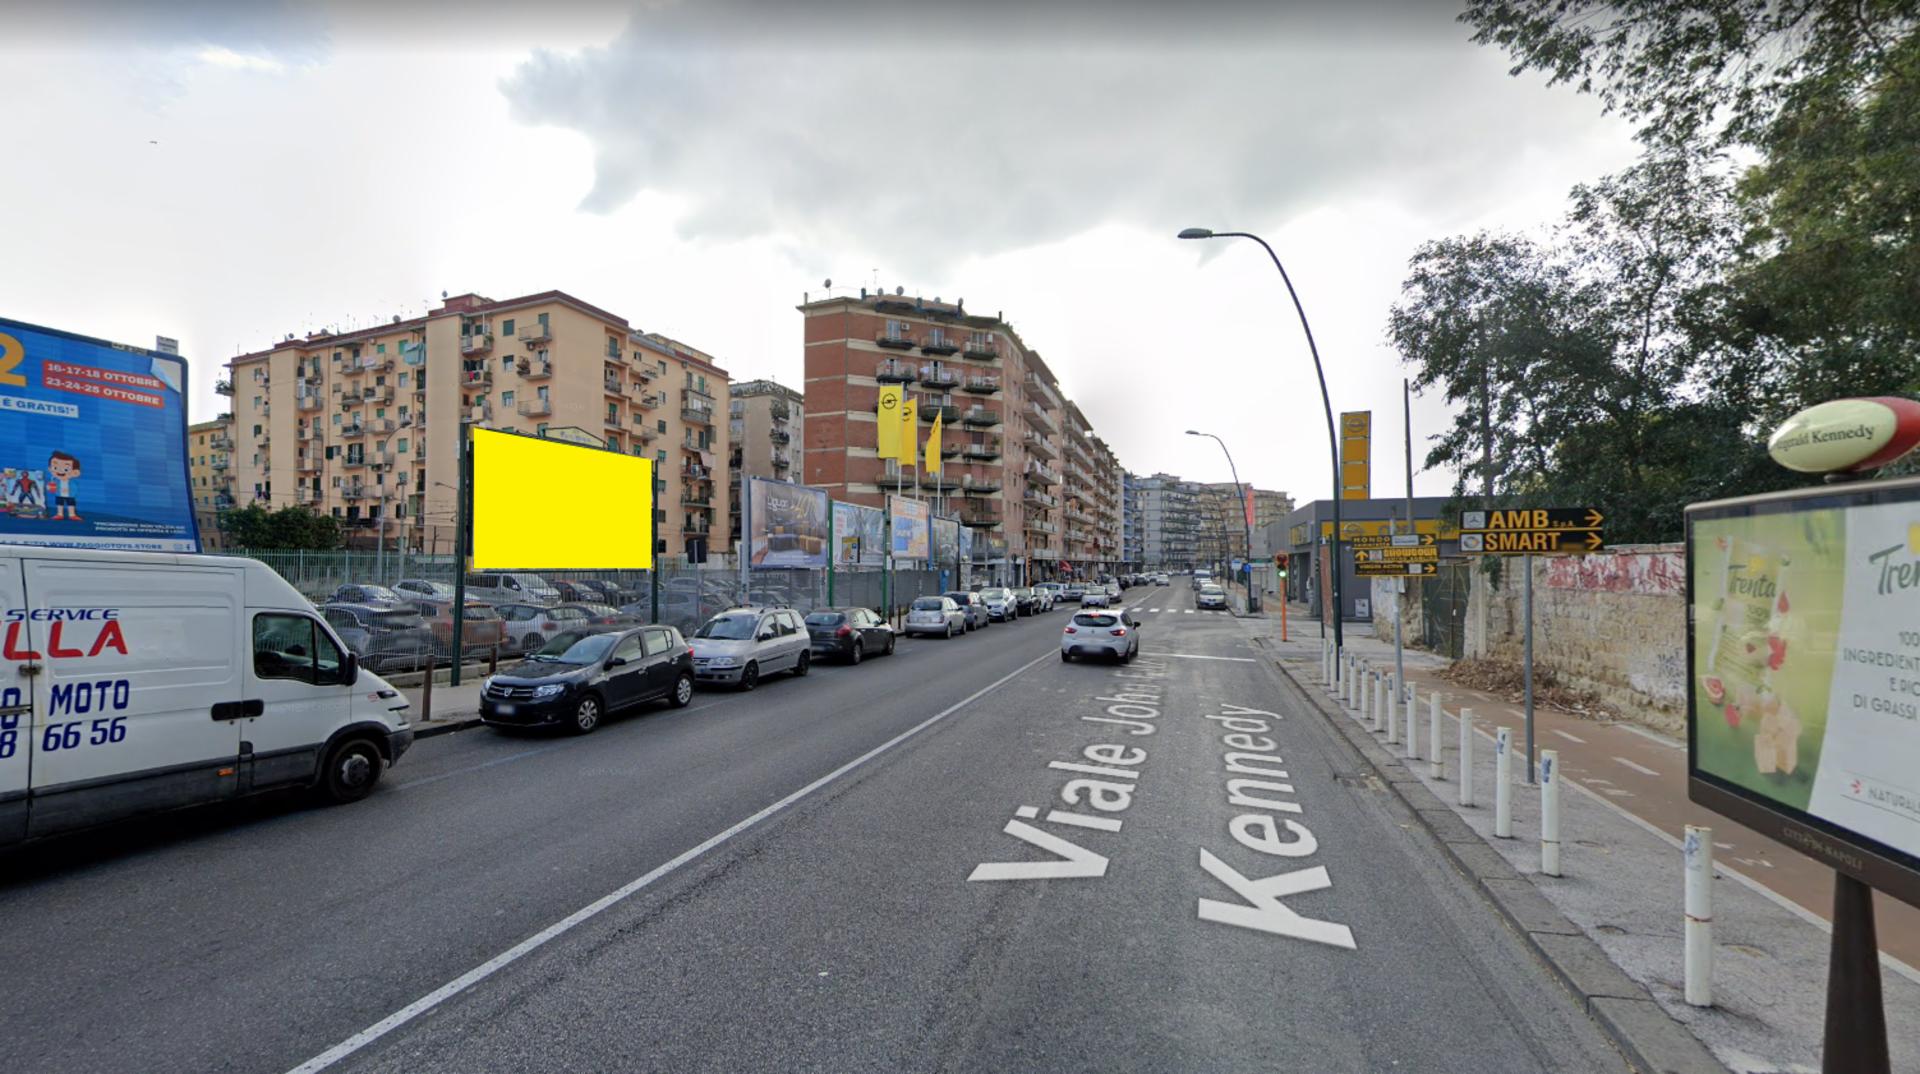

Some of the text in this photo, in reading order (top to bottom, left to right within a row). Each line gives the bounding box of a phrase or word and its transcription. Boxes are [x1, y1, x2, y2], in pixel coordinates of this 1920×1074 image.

[47, 363, 160, 388] 16-17-18 OTTOBRE
[46, 377, 160, 404] 23-24-25 OTTOBRE
[1812, 424, 1875, 443] Kennedy
[1488, 510, 1549, 529] AMB
[1485, 532, 1561, 551] SMART
[1728, 564, 1777, 598] Trenta
[5, 608, 120, 622] SERVICE
[0, 619, 128, 661] LLA
[49, 679, 130, 717] MOTO
[1853, 693, 1918, 721] DI GRASSI
[42, 723, 82, 752] 66
[90, 716, 128, 746] 56
